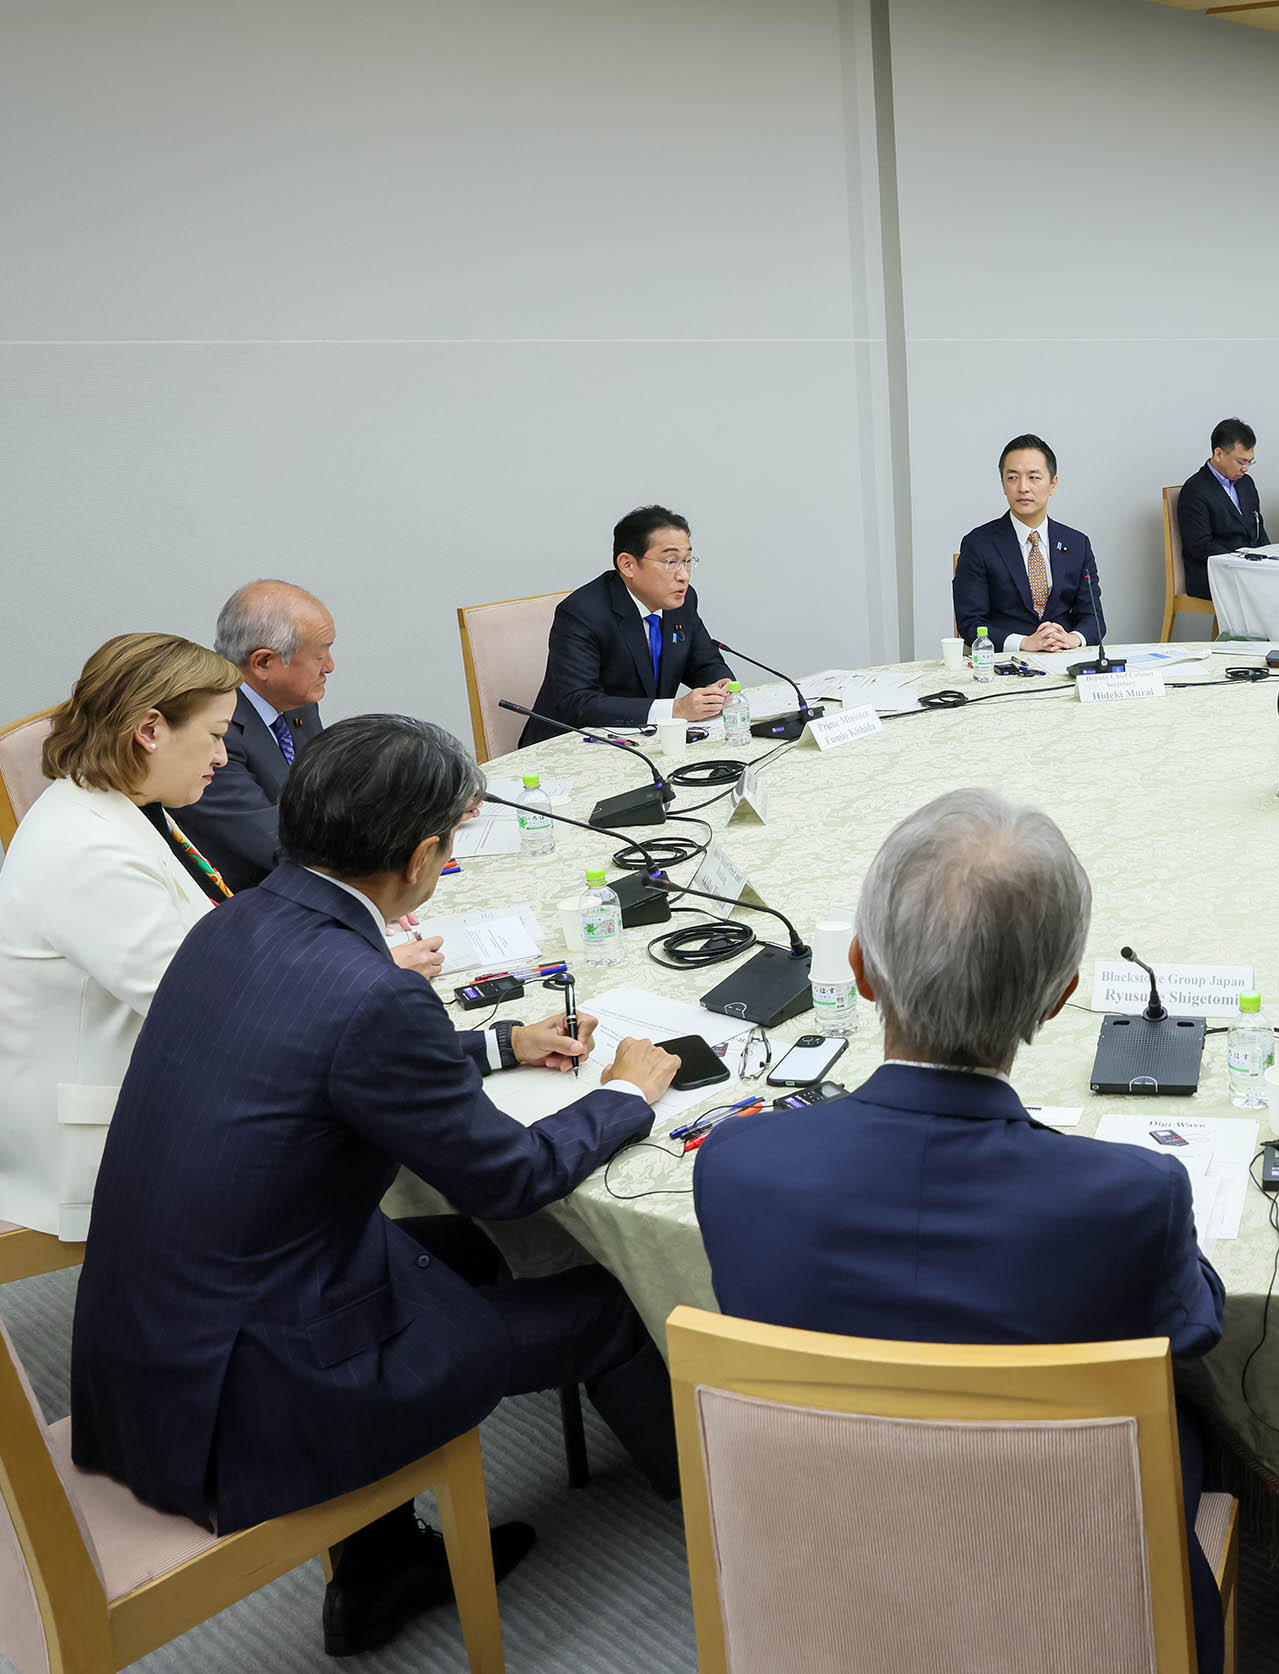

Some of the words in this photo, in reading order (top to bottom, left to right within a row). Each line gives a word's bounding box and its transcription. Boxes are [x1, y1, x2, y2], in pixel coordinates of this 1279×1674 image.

[1092, 690, 1124, 700] Hideki
[1126, 688, 1154, 698] Murai
[817, 722, 840, 733] Prime
[840, 710, 870, 724] Minister
[824, 732, 849, 745] Fumio
[848, 722, 877, 738] Kishida
[1101, 971, 1165, 984] Blackstoe
[1168, 974, 1207, 988] Group
[1209, 975, 1246, 988] Japan
[1168, 991, 1239, 1006] Shigetomi
